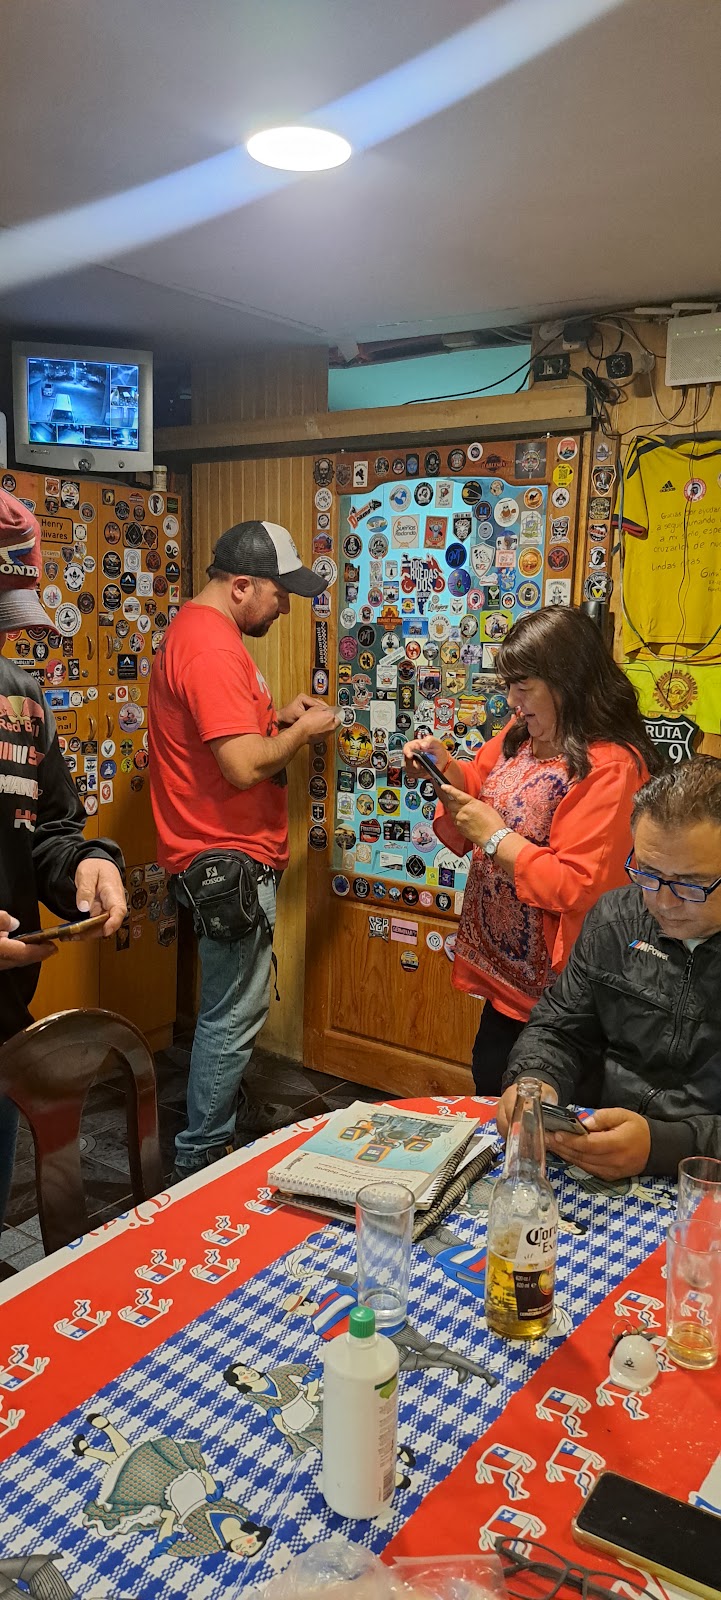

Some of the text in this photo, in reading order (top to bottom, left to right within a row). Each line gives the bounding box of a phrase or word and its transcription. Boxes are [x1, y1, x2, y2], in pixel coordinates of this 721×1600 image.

[41, 518, 64, 531] Henry
[687, 516, 716, 527] umando
[41, 530, 68, 540] livares
[410, 560, 424, 570] DOS
[410, 568, 438, 580] RUEDAS
[416, 579, 433, 592] DOS
[0, 719, 21, 733] Red
[645, 725, 683, 740] RUTA
